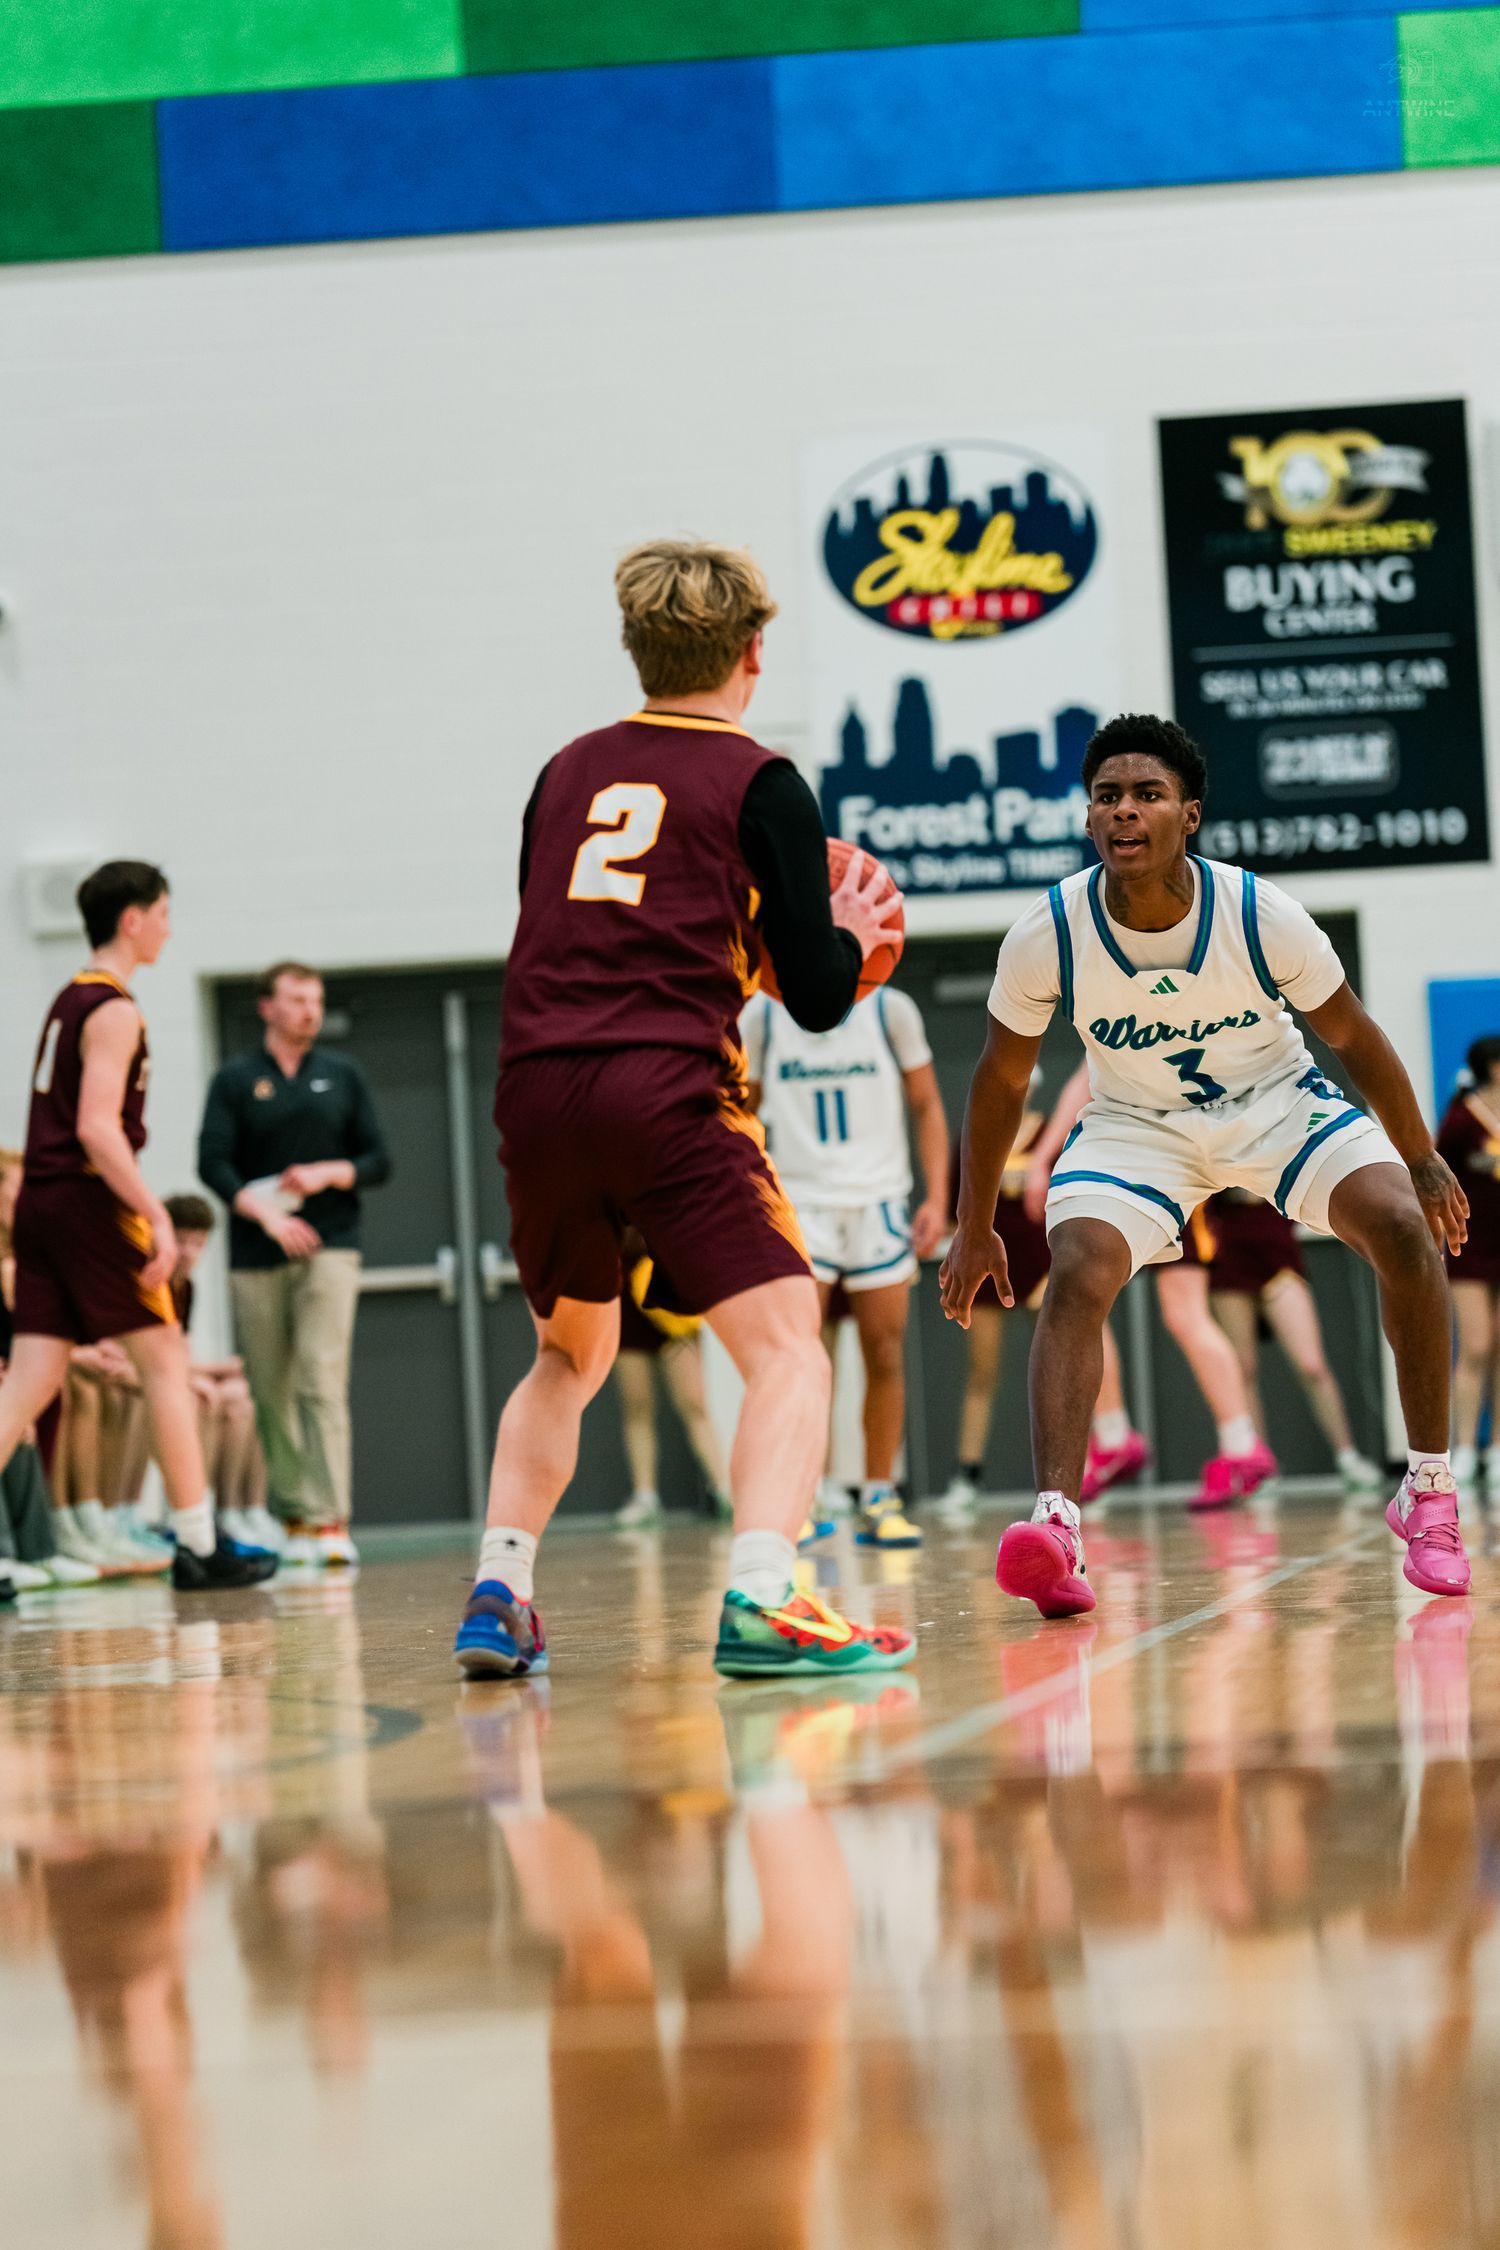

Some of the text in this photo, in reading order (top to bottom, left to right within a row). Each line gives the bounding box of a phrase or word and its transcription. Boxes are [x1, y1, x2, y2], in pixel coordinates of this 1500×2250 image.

[1284, 519, 1437, 557] SWEENEY
[1224, 555, 1416, 612] BUYING
[1263, 602, 1378, 638] CENTER
[1386, 657, 1448, 690] CAR
[567, 782, 667, 907] 2
[839, 795, 990, 849] Forest
[1089, 1009, 1261, 1050] Warriors
[1162, 1048, 1227, 1105] 3
[815, 1089, 848, 1143] 11
